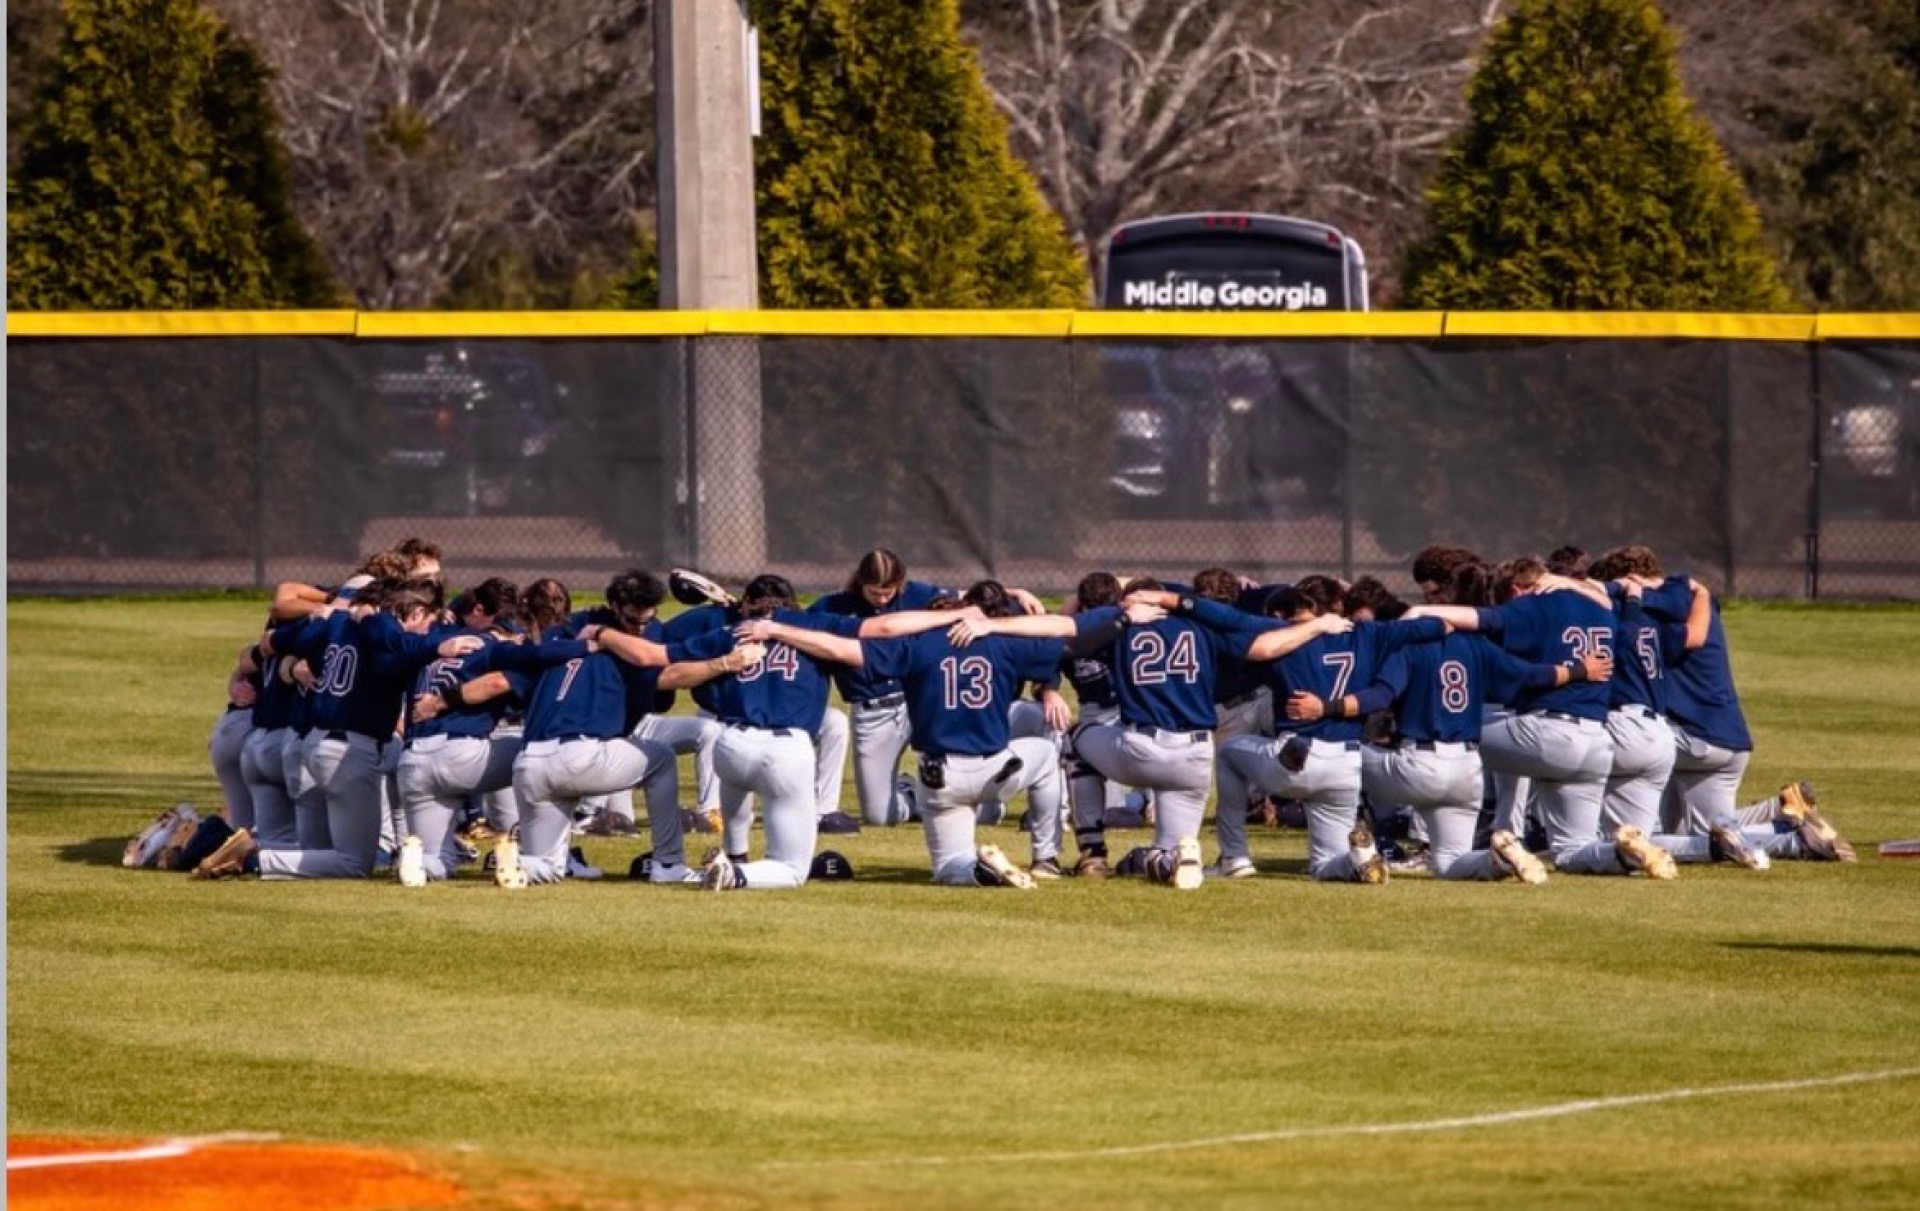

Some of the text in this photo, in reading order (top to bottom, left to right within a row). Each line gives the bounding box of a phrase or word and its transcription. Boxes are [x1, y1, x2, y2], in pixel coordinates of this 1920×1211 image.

[1124, 281, 1327, 309] Middle Georgia
[311, 644, 358, 696] 30
[1131, 630, 1200, 686] 24
[1562, 626, 1613, 669] 35
[554, 657, 585, 702] 1
[940, 656, 992, 710] 13
[1323, 651, 1355, 701] 7
[1440, 660, 1468, 713] 8
[826, 859, 838, 874] E
